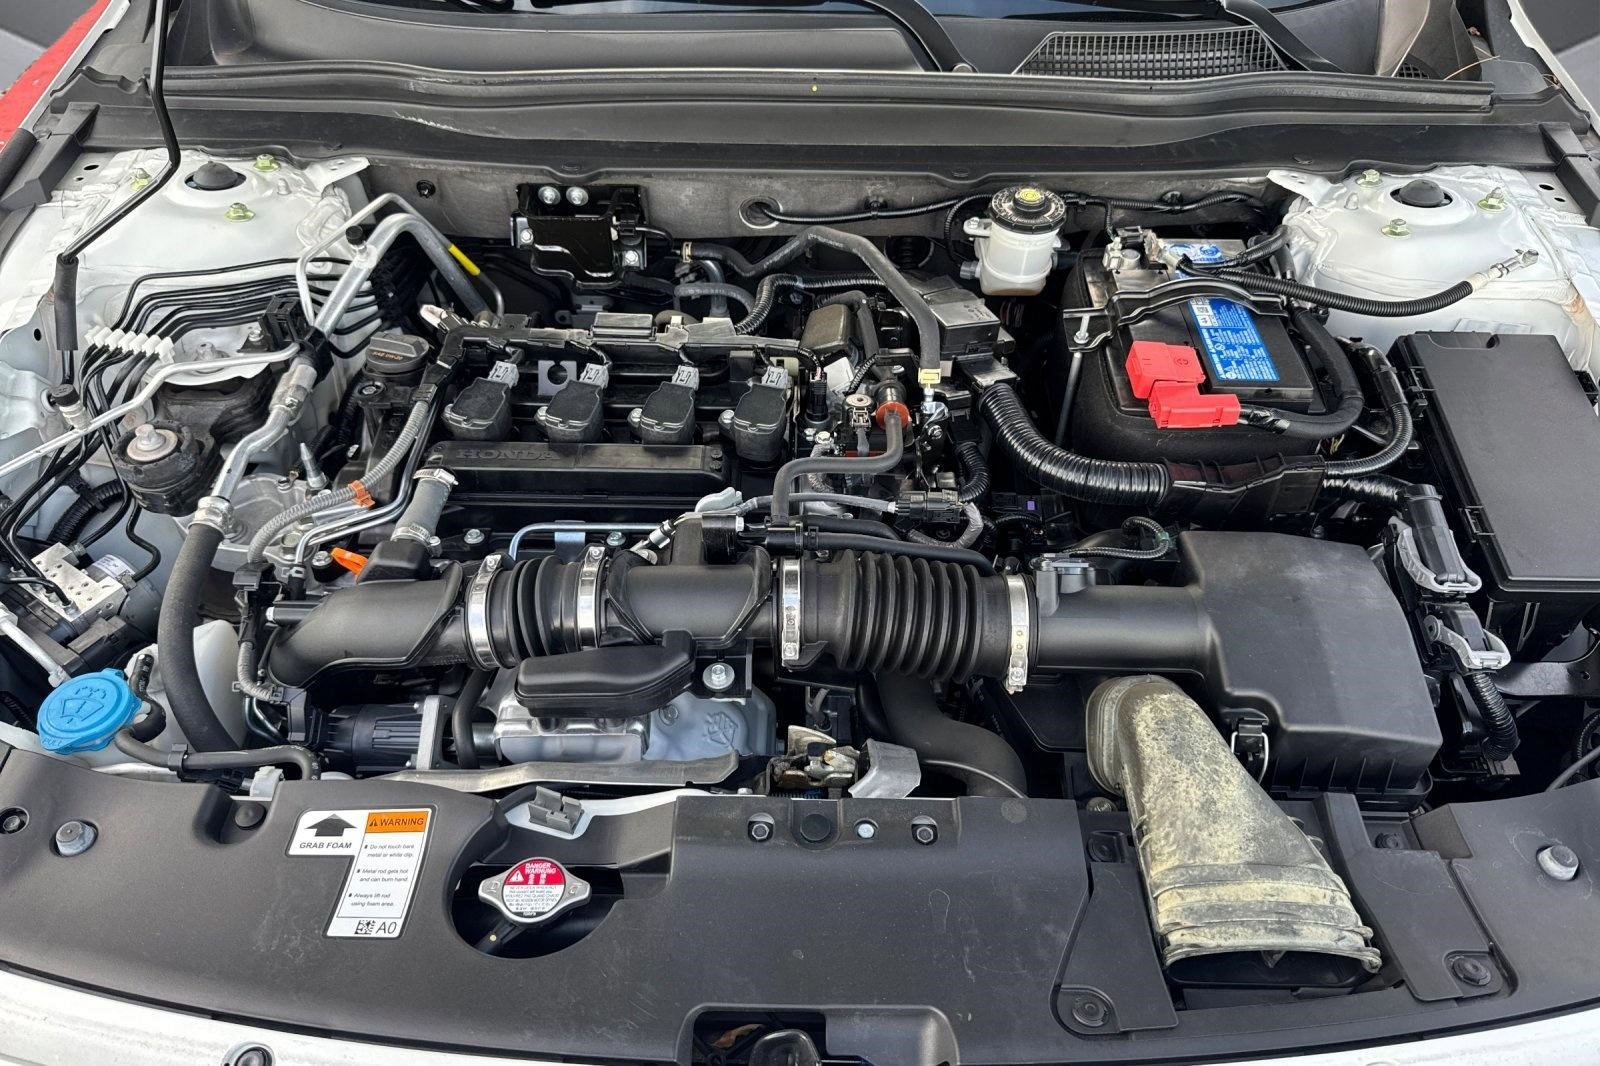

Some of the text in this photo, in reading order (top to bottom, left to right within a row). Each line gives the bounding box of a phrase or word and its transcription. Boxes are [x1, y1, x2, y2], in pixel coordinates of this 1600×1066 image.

[456, 449, 561, 460] HONDA
[380, 817, 424, 827] WARNING
[375, 921, 397, 935] A0
